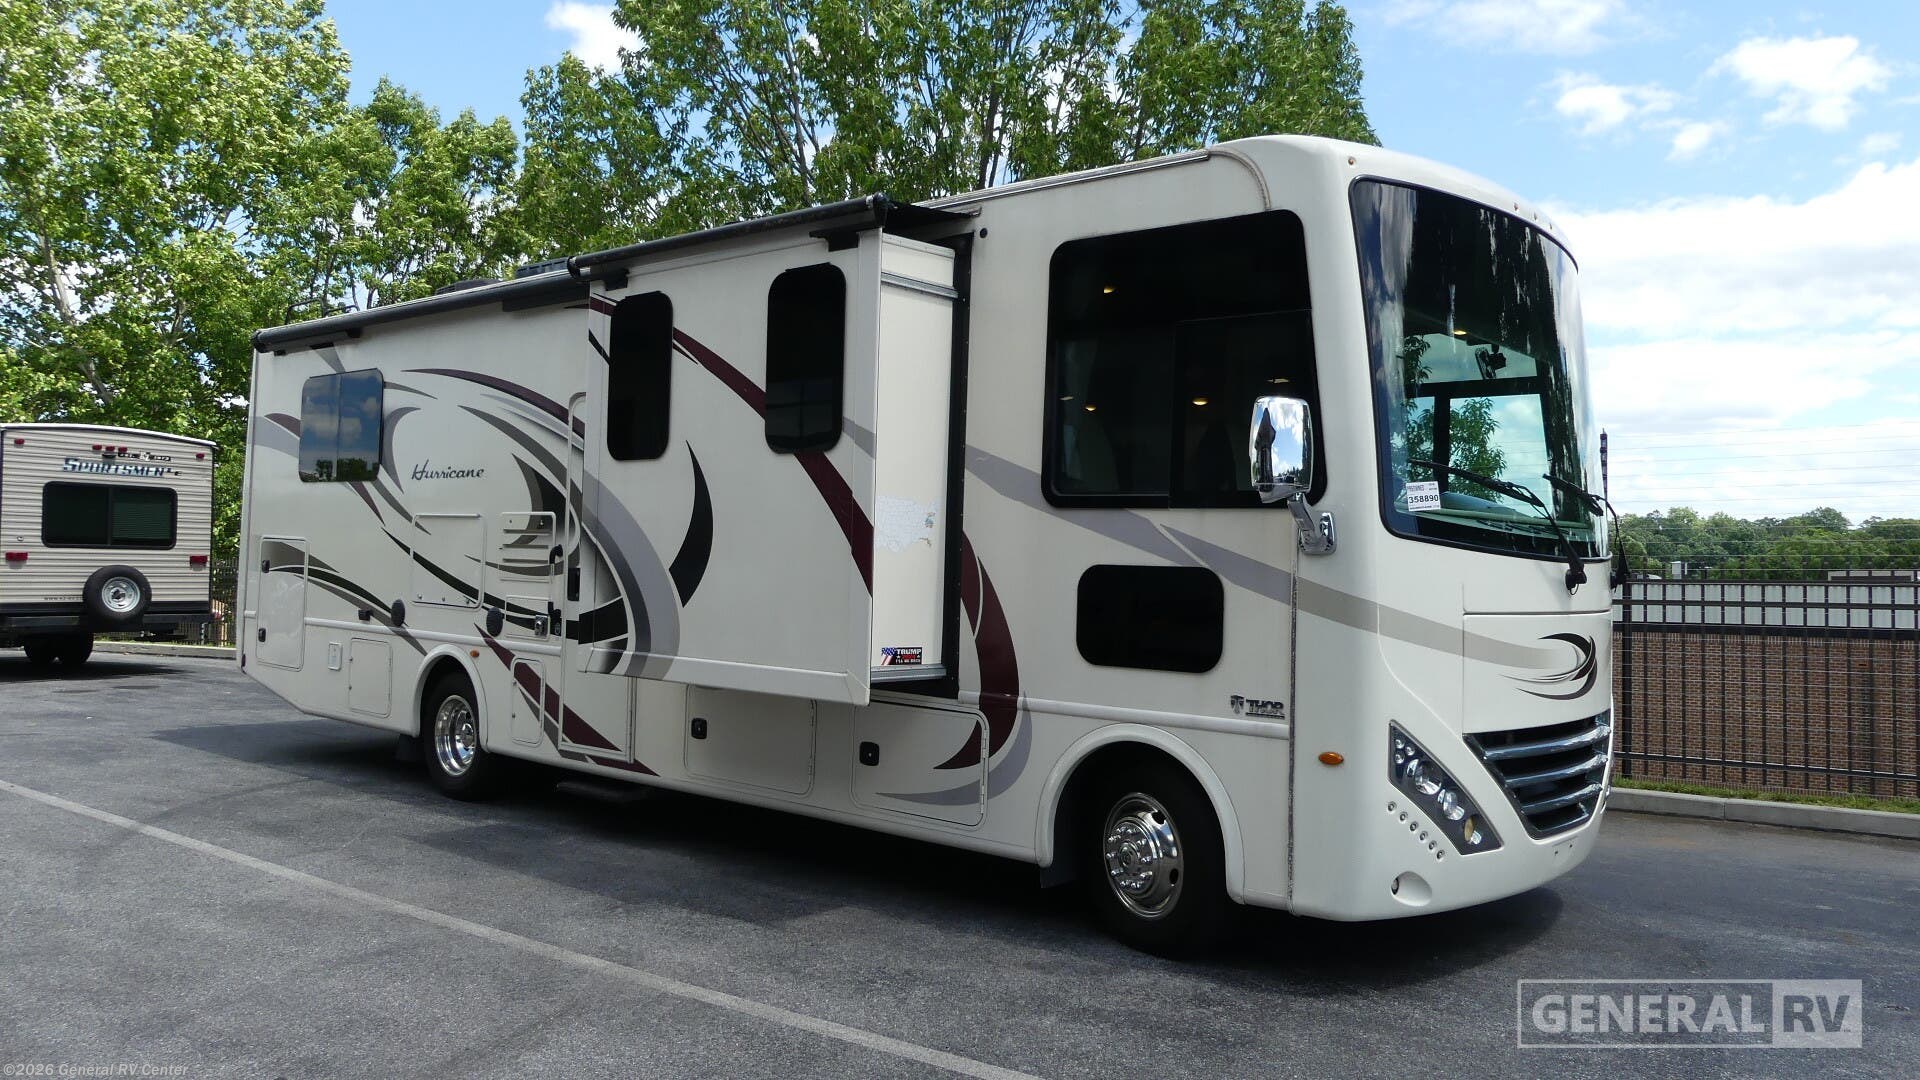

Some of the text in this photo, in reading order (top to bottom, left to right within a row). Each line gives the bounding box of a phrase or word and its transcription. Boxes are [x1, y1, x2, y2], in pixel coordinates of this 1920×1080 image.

[63, 457, 165, 478] SPORTSMEN
[411, 459, 485, 481] Hurricane
[1408, 494, 1439, 504] 358890
[1245, 698, 1285, 715] THOR
